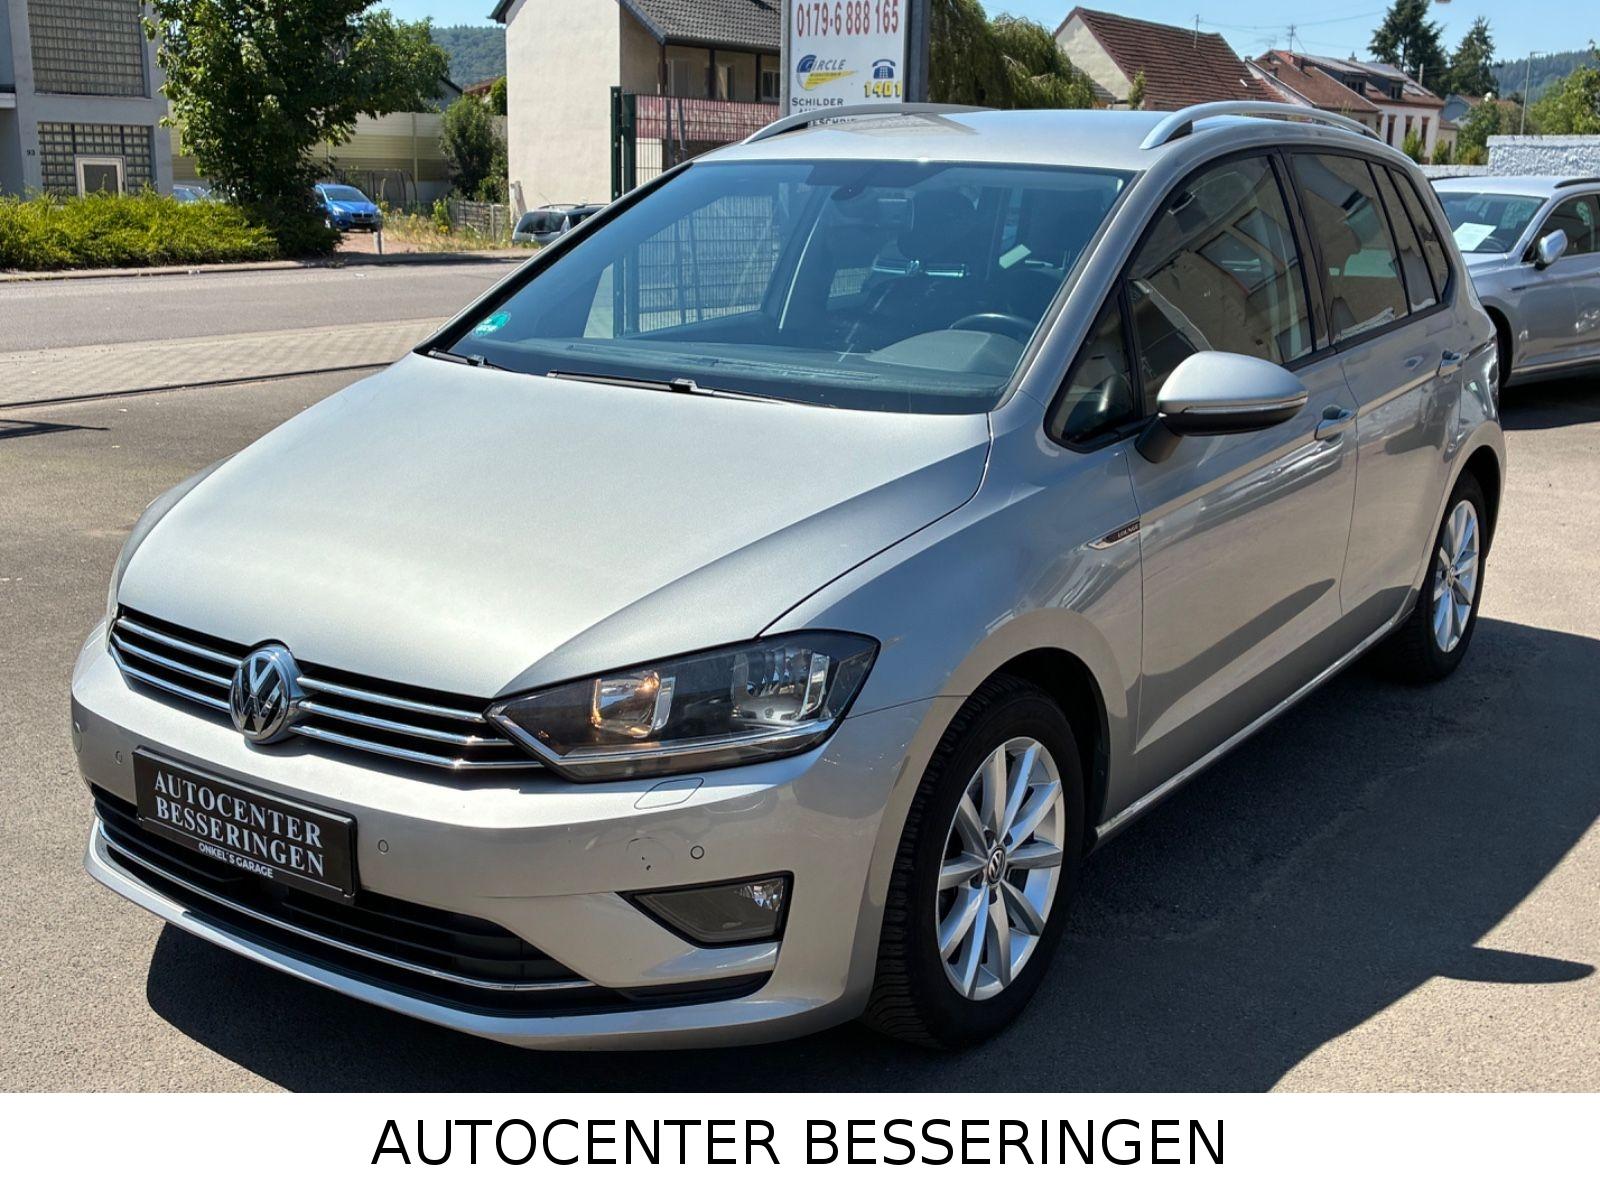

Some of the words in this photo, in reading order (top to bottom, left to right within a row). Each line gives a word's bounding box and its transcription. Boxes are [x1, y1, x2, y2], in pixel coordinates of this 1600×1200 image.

[797, 1, 842, 37] 0179-6
[846, 0, 870, 36] 888
[875, 0, 899, 34] 165
[791, 96, 844, 107] SCHILDER
[864, 80, 903, 98] 1401
[154, 770, 323, 849] AUTOCENTER
[155, 795, 325, 878] BESSERINGEN
[235, 857, 274, 879] GARAGE
